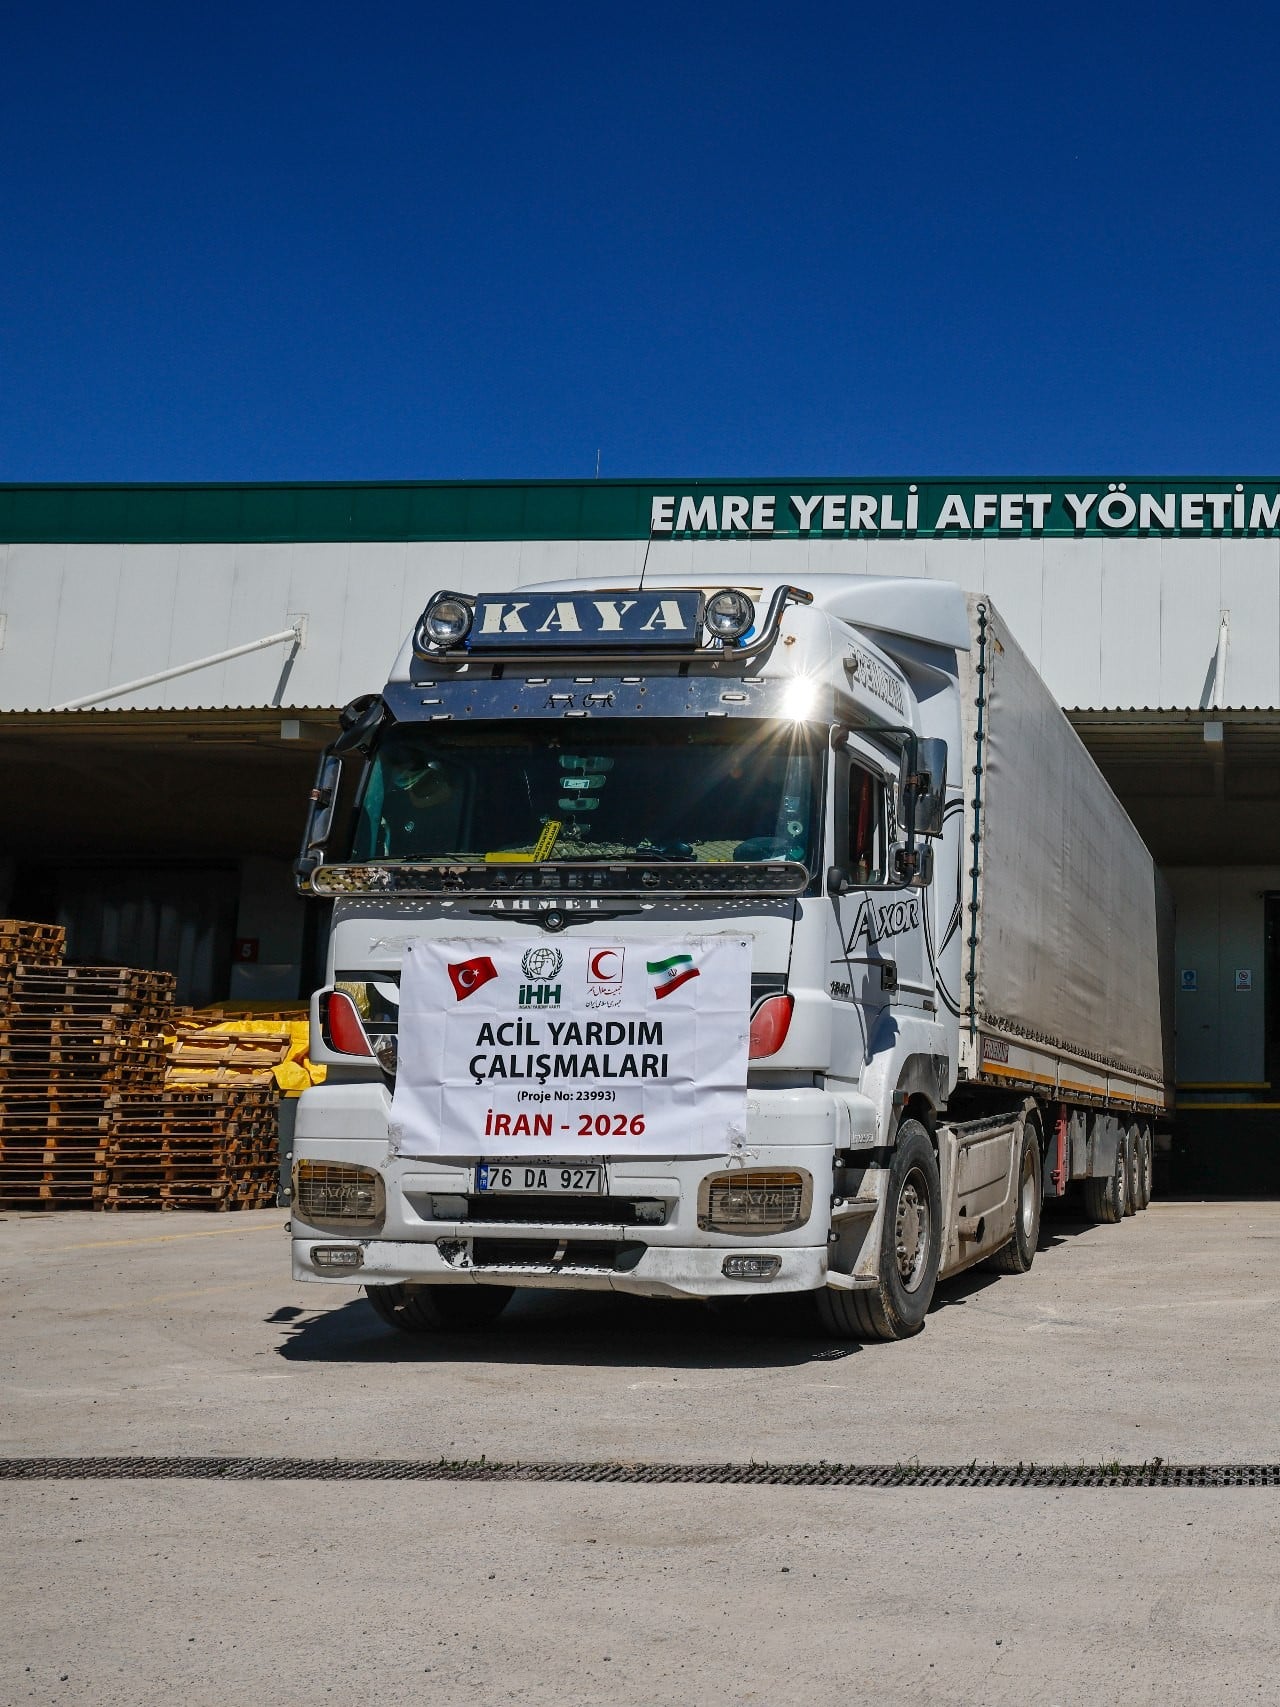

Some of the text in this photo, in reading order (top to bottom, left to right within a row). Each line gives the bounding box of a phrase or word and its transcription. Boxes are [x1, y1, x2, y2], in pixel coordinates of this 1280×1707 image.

[651, 495, 776, 531] EMRE
[789, 484, 918, 530] YERLİ
[935, 493, 1052, 529] AFET
[478, 600, 688, 634] KAYA
[242, 944, 251, 958] 5
[475, 1017, 663, 1047] ACİL YARDIM
[469, 1053, 668, 1085] ÇALIŞMALARI
[517, 1091, 616, 1104] (Proje No: 23993)
[485, 1109, 553, 1137] İRAN
[577, 1114, 646, 1137] 2026
[489, 1168, 596, 1189] 76 DA 927
